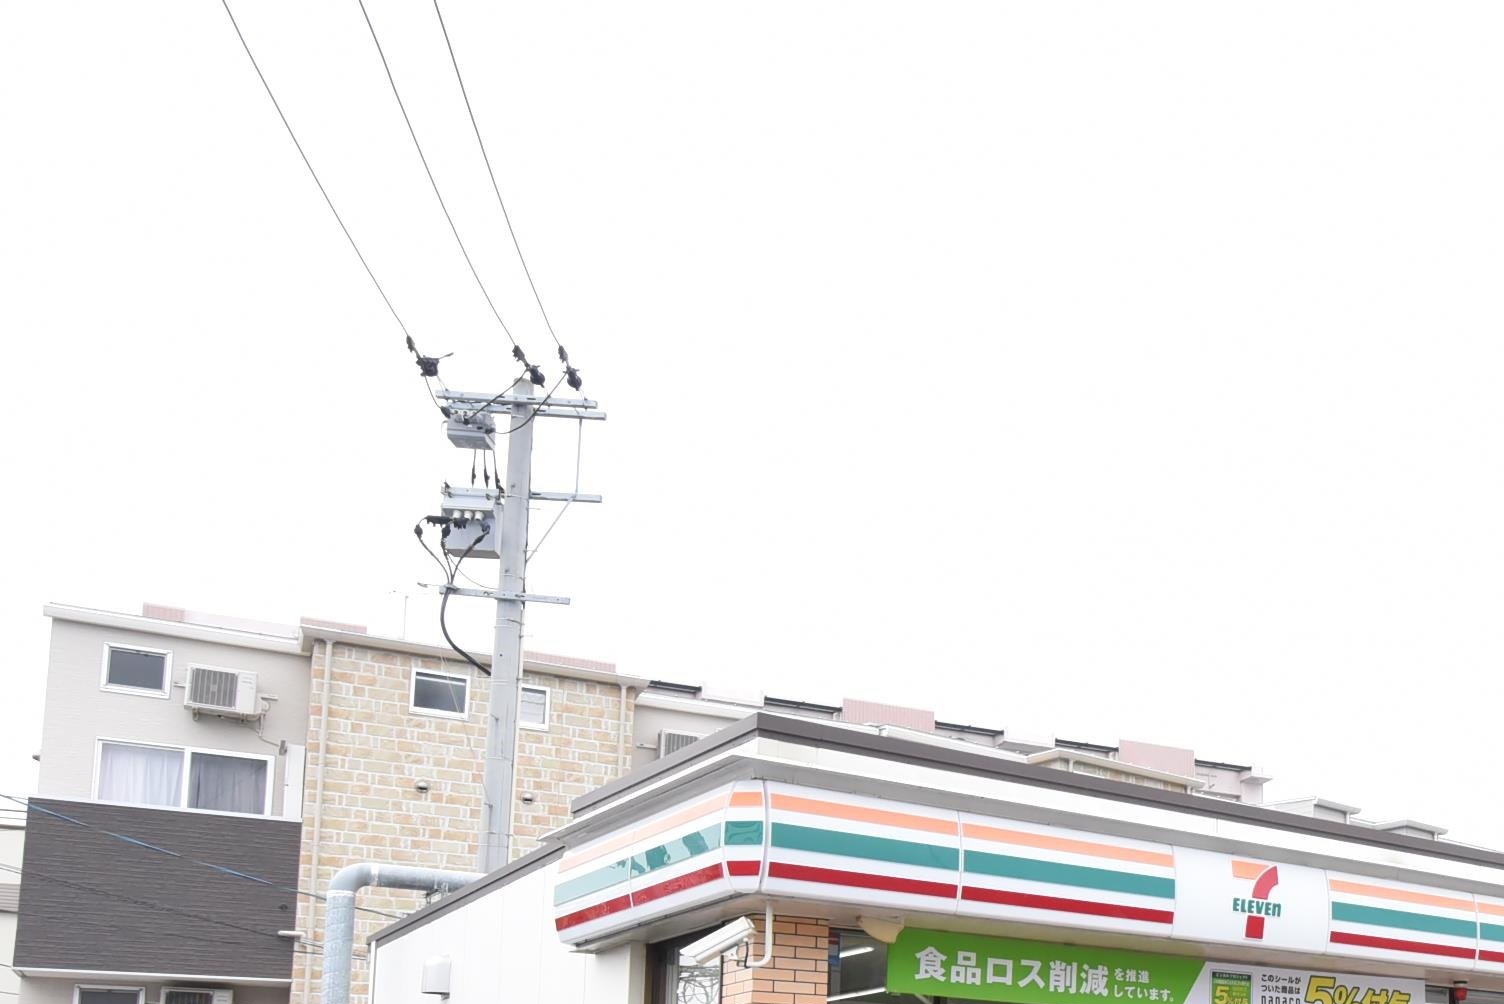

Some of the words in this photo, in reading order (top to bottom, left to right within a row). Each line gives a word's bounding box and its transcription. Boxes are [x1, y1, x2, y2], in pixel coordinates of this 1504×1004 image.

[914, 946, 1109, 998] 食品ロス削減
[1113, 967, 1150, 984] を推進
[1260, 973, 1302, 985] このシールが
[1113, 984, 1175, 1003] しています。
[1260, 984, 1301, 995] ついた商品は
